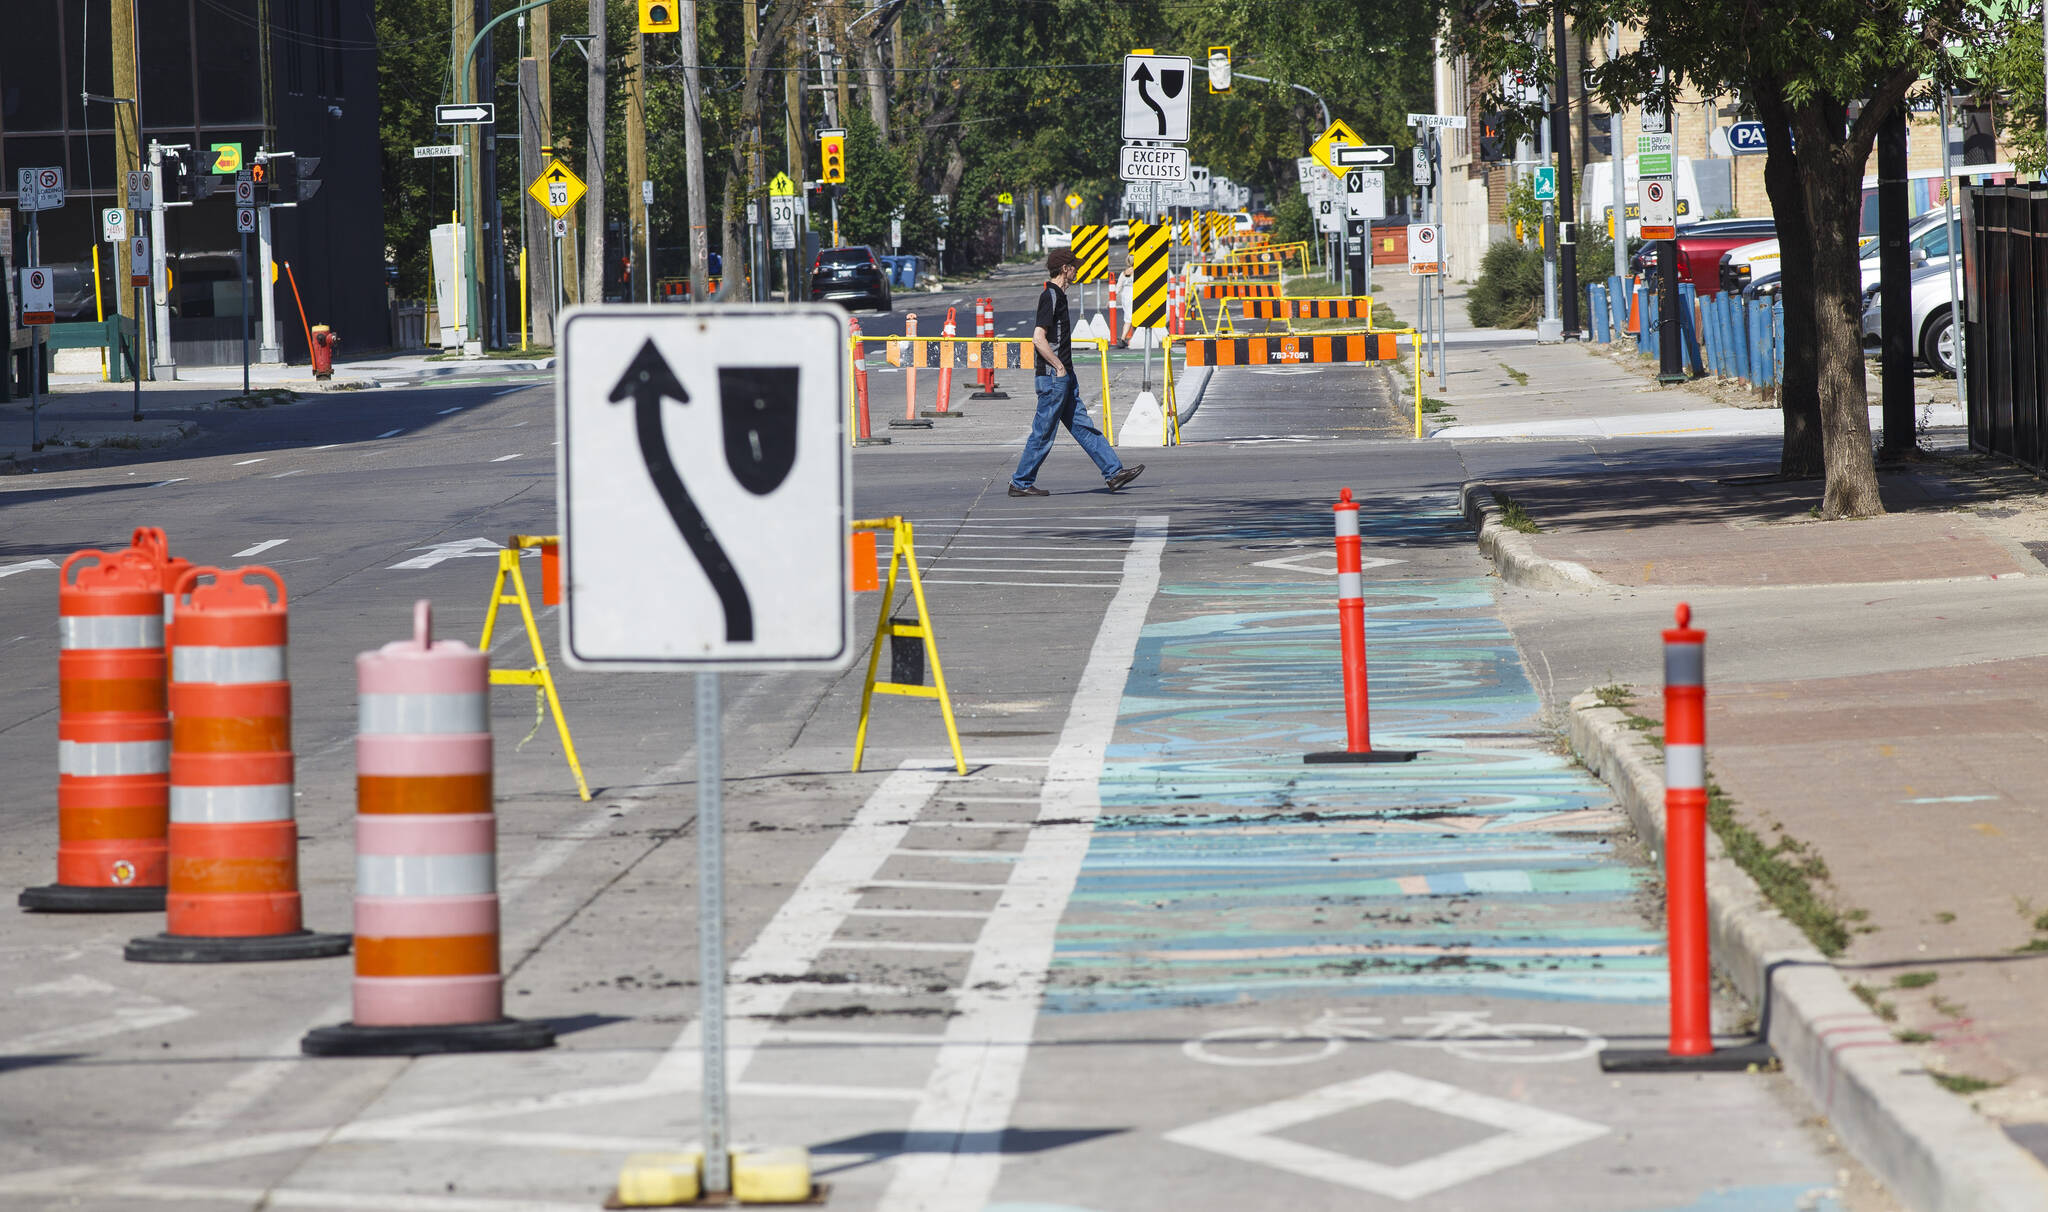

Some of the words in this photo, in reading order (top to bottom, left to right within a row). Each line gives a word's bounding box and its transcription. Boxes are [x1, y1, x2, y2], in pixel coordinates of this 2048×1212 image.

[1652, 136, 1662, 144] pay
[1738, 128, 1766, 144] PA
[417, 147, 452, 156] HARGRAVE
[1652, 144, 1671, 152] phone
[1133, 151, 1176, 163] EXCEPT
[1127, 164, 1181, 177] CYCLISTS
[551, 192, 566, 204] 30
[774, 206, 791, 220] 30
[1271, 351, 1309, 359] 783-7091
